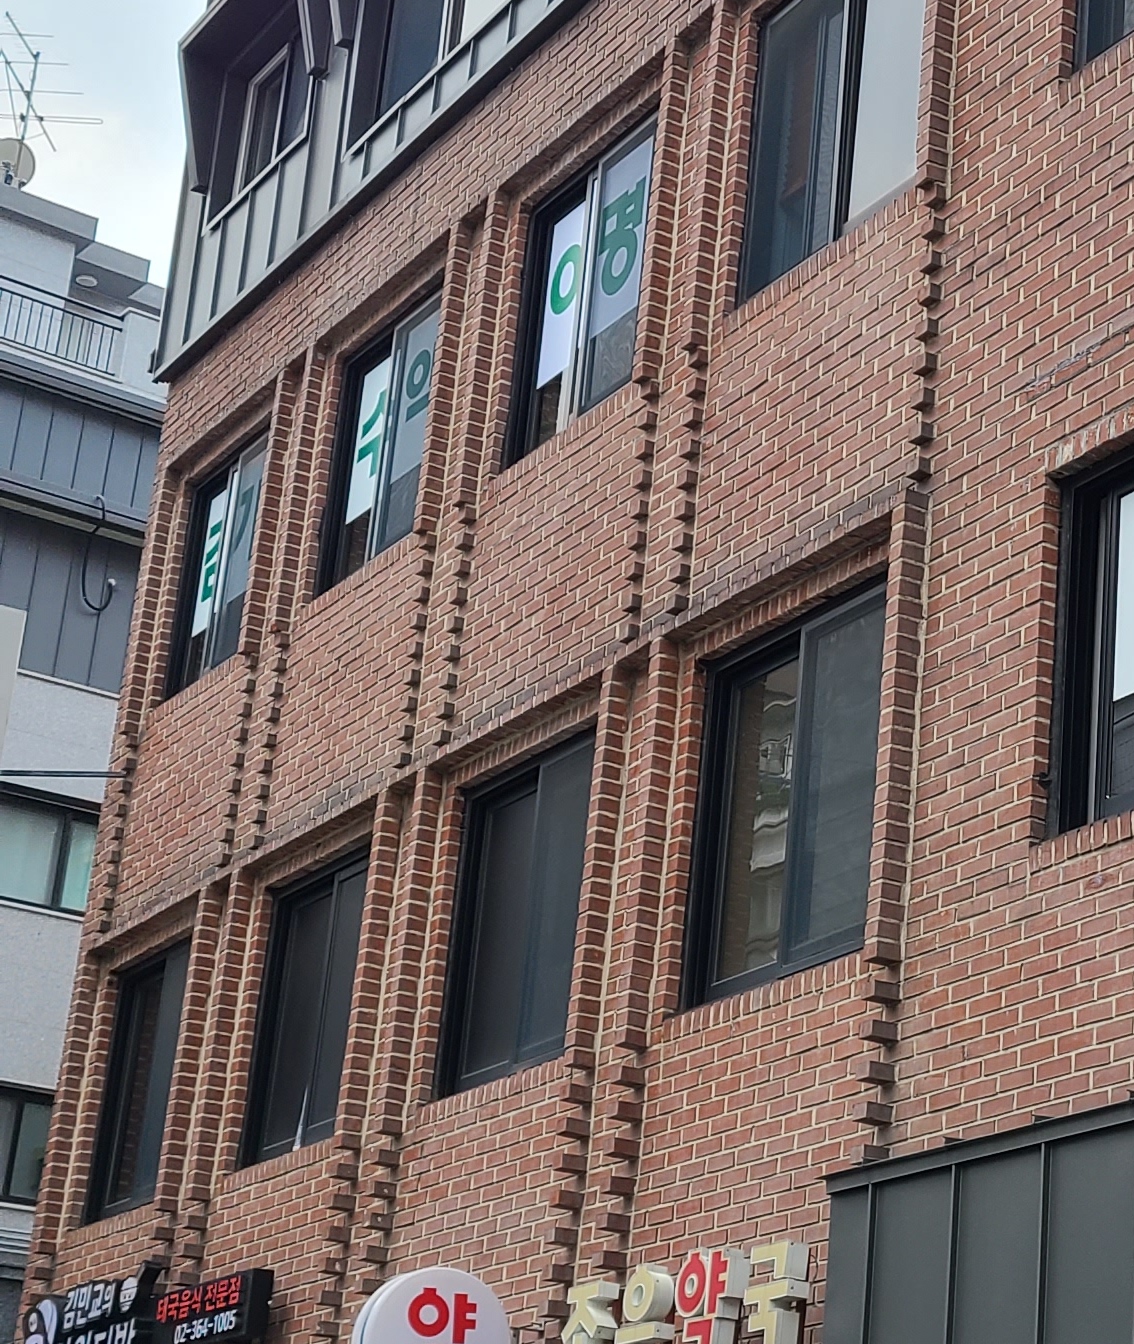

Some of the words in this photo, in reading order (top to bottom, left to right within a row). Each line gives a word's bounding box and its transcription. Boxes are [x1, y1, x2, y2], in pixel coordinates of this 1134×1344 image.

[63, 1280, 115, 1330] 김민교의
[155, 1289, 201, 1324] 태국음식
[204, 1274, 242, 1313] 전문점
